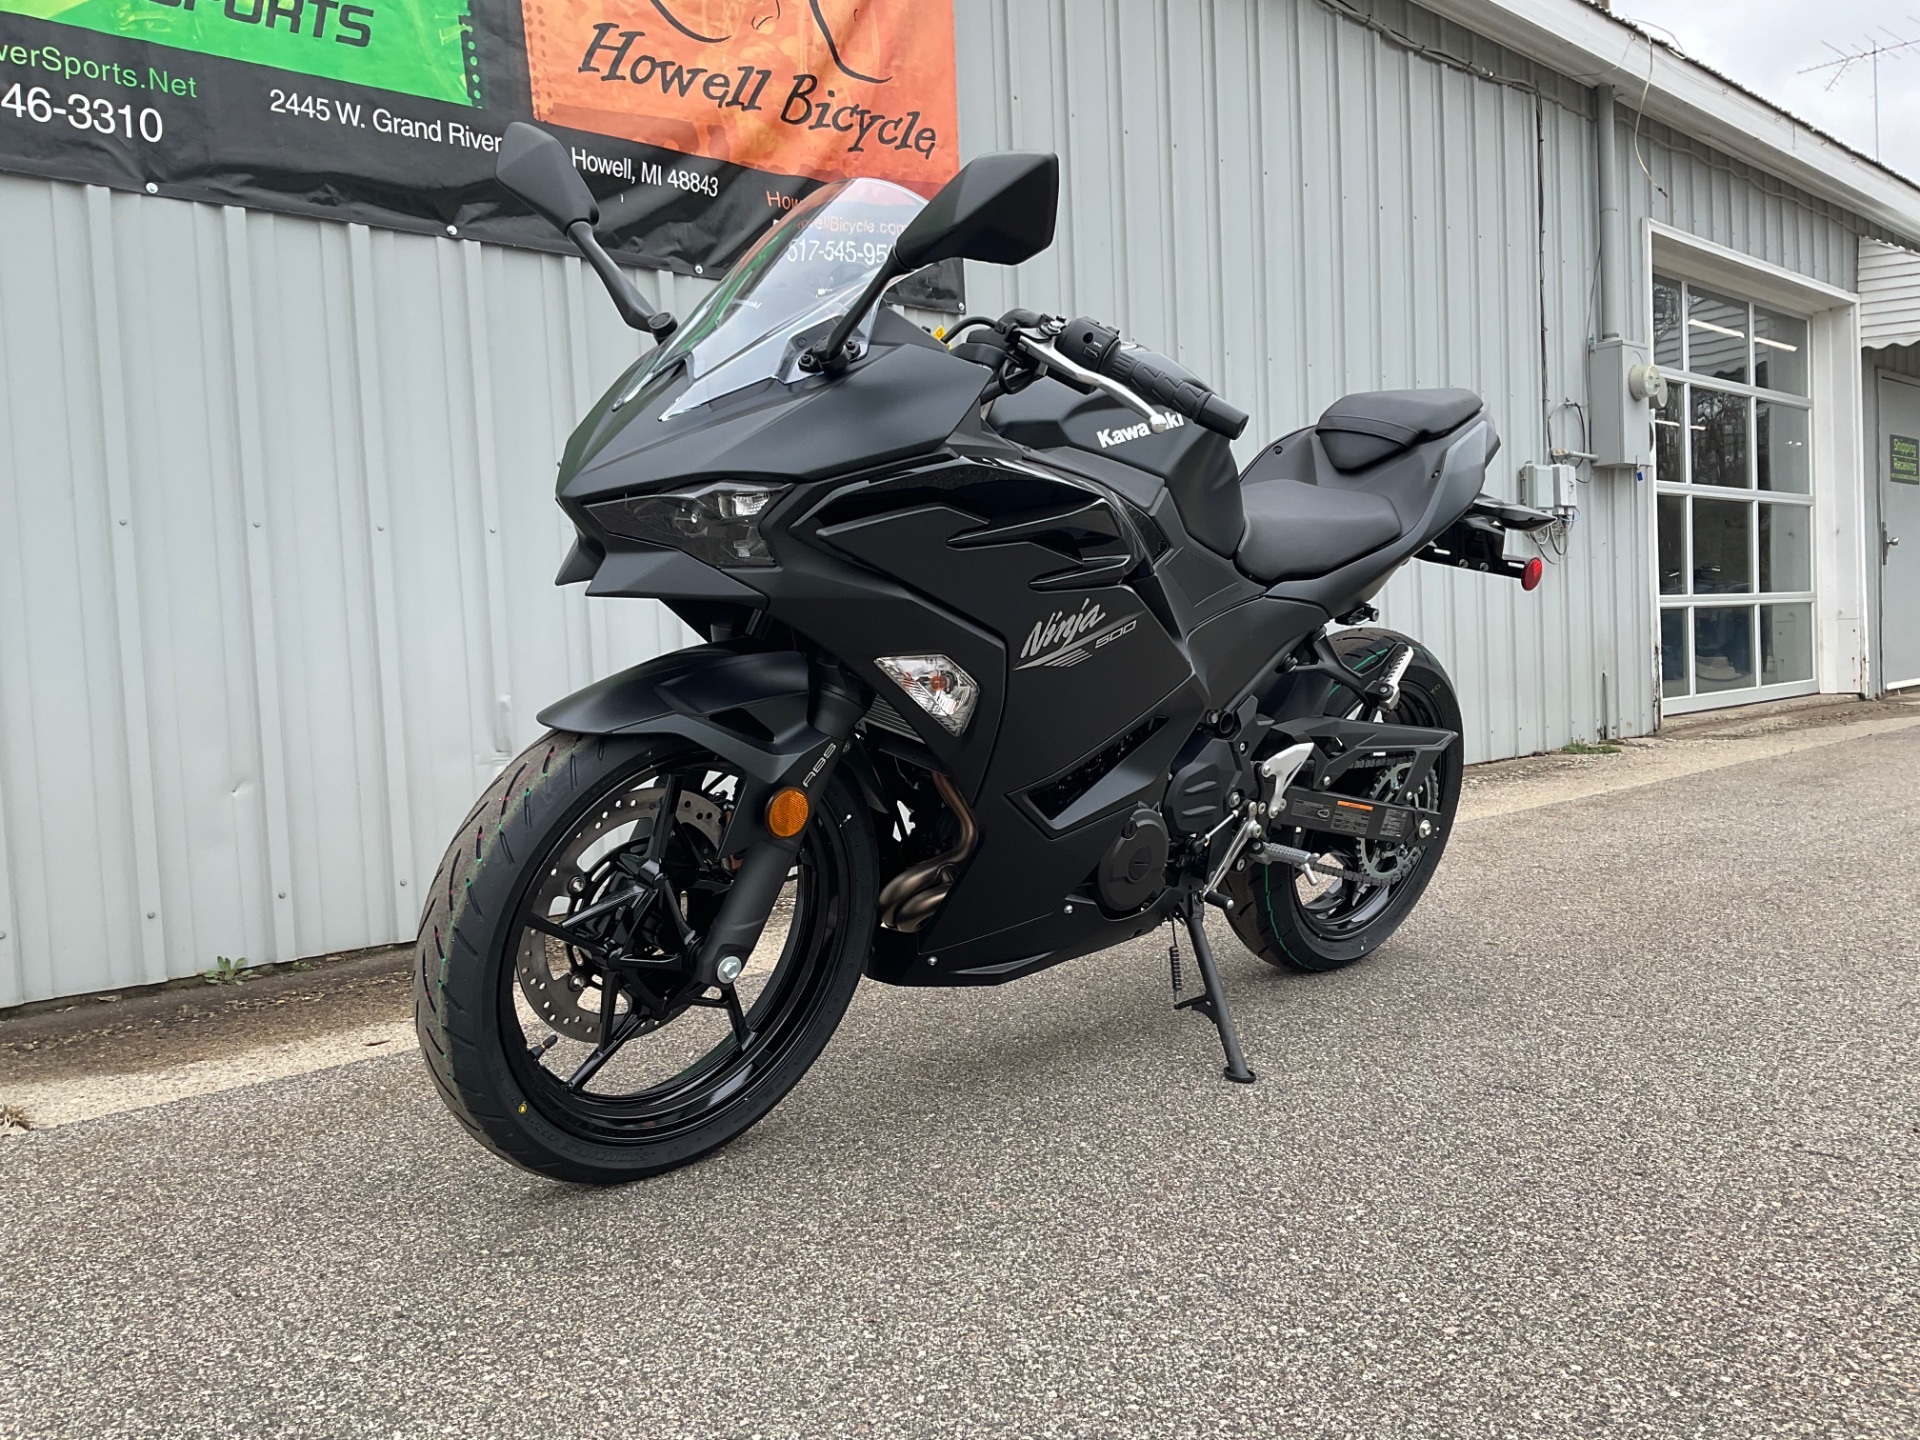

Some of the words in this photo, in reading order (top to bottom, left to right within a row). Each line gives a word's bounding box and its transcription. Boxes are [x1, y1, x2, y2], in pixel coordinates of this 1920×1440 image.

[577, 22, 772, 112] Howell
[780, 74, 937, 160] Bicycle
[269, 89, 331, 121] 2445
[335, 100, 366, 129] W.
[372, 108, 442, 142] Grand
[449, 122, 503, 153] River
[571, 146, 636, 184] Howell,
[641, 161, 662, 186] MI
[667, 169, 719, 198] 48843
[1020, 598, 1106, 654] Ninja
[1094, 619, 1137, 649] 500
[802, 742, 837, 788] ABS
